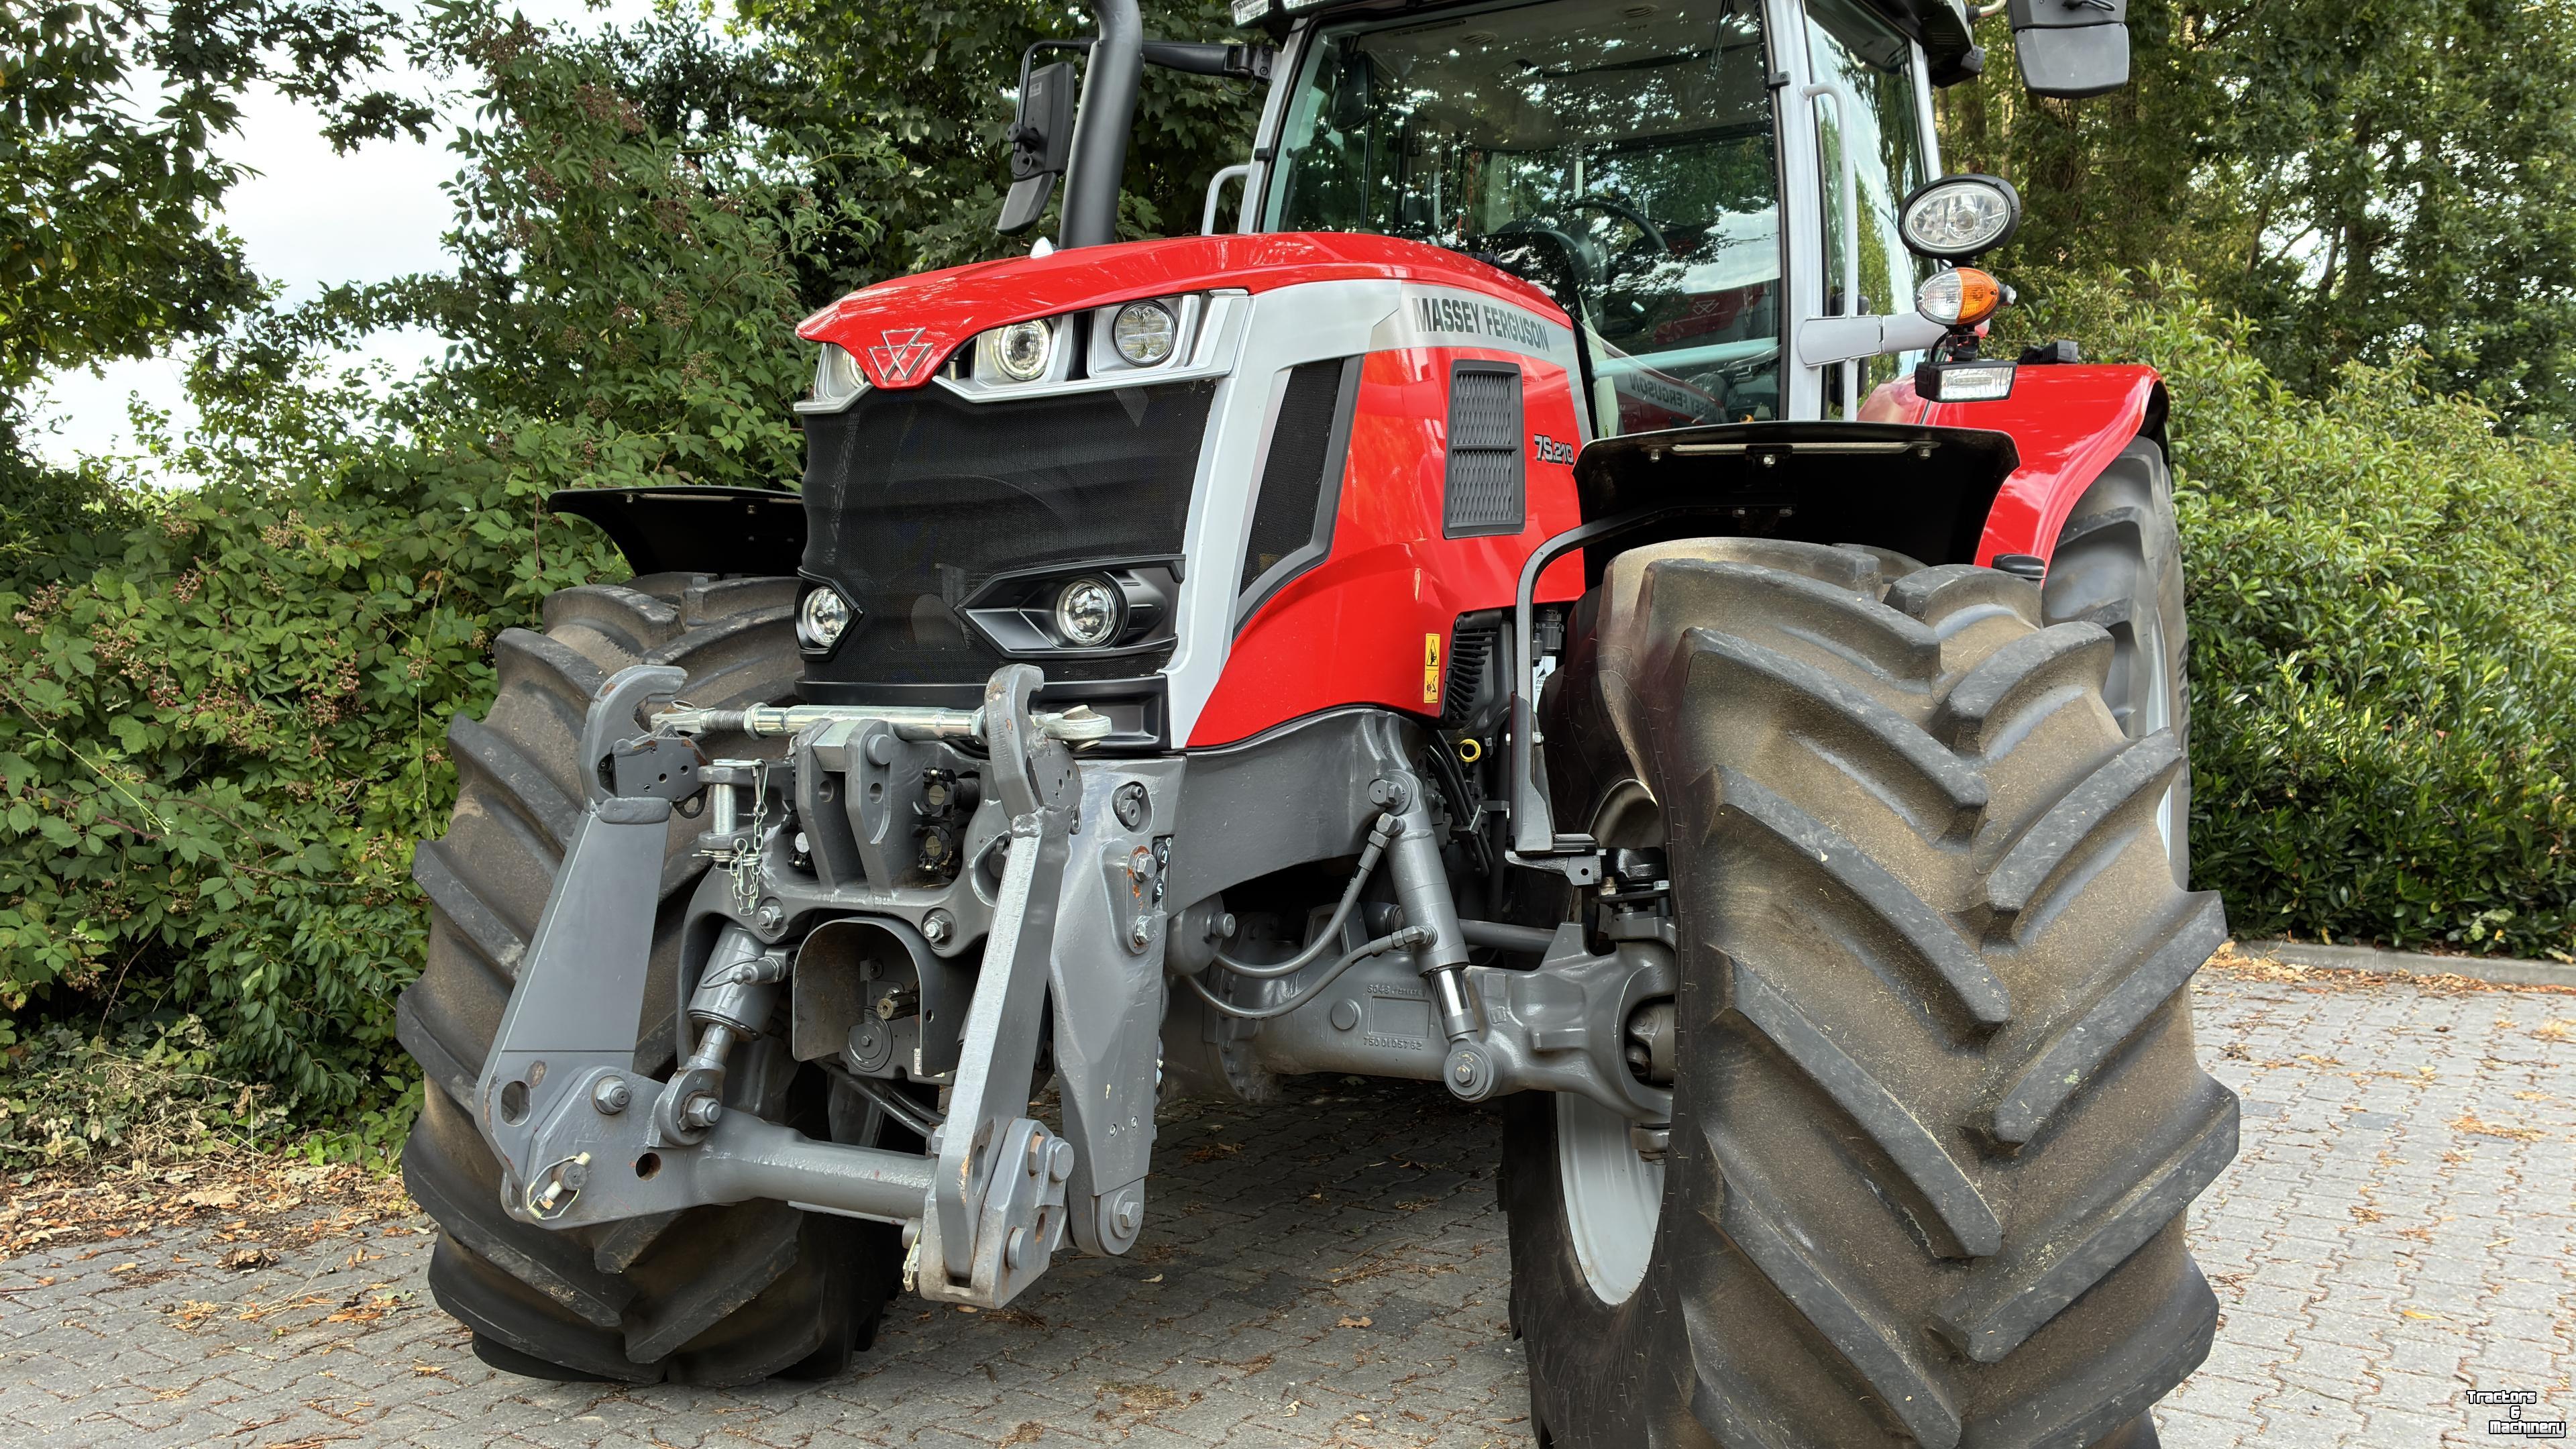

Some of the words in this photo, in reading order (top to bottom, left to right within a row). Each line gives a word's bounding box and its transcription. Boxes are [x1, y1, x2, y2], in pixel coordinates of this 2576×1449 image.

[1411, 297, 1481, 334] MASSEY
[1483, 305, 1551, 353] FERGUSON
[1534, 433, 1574, 466] 7S.210
